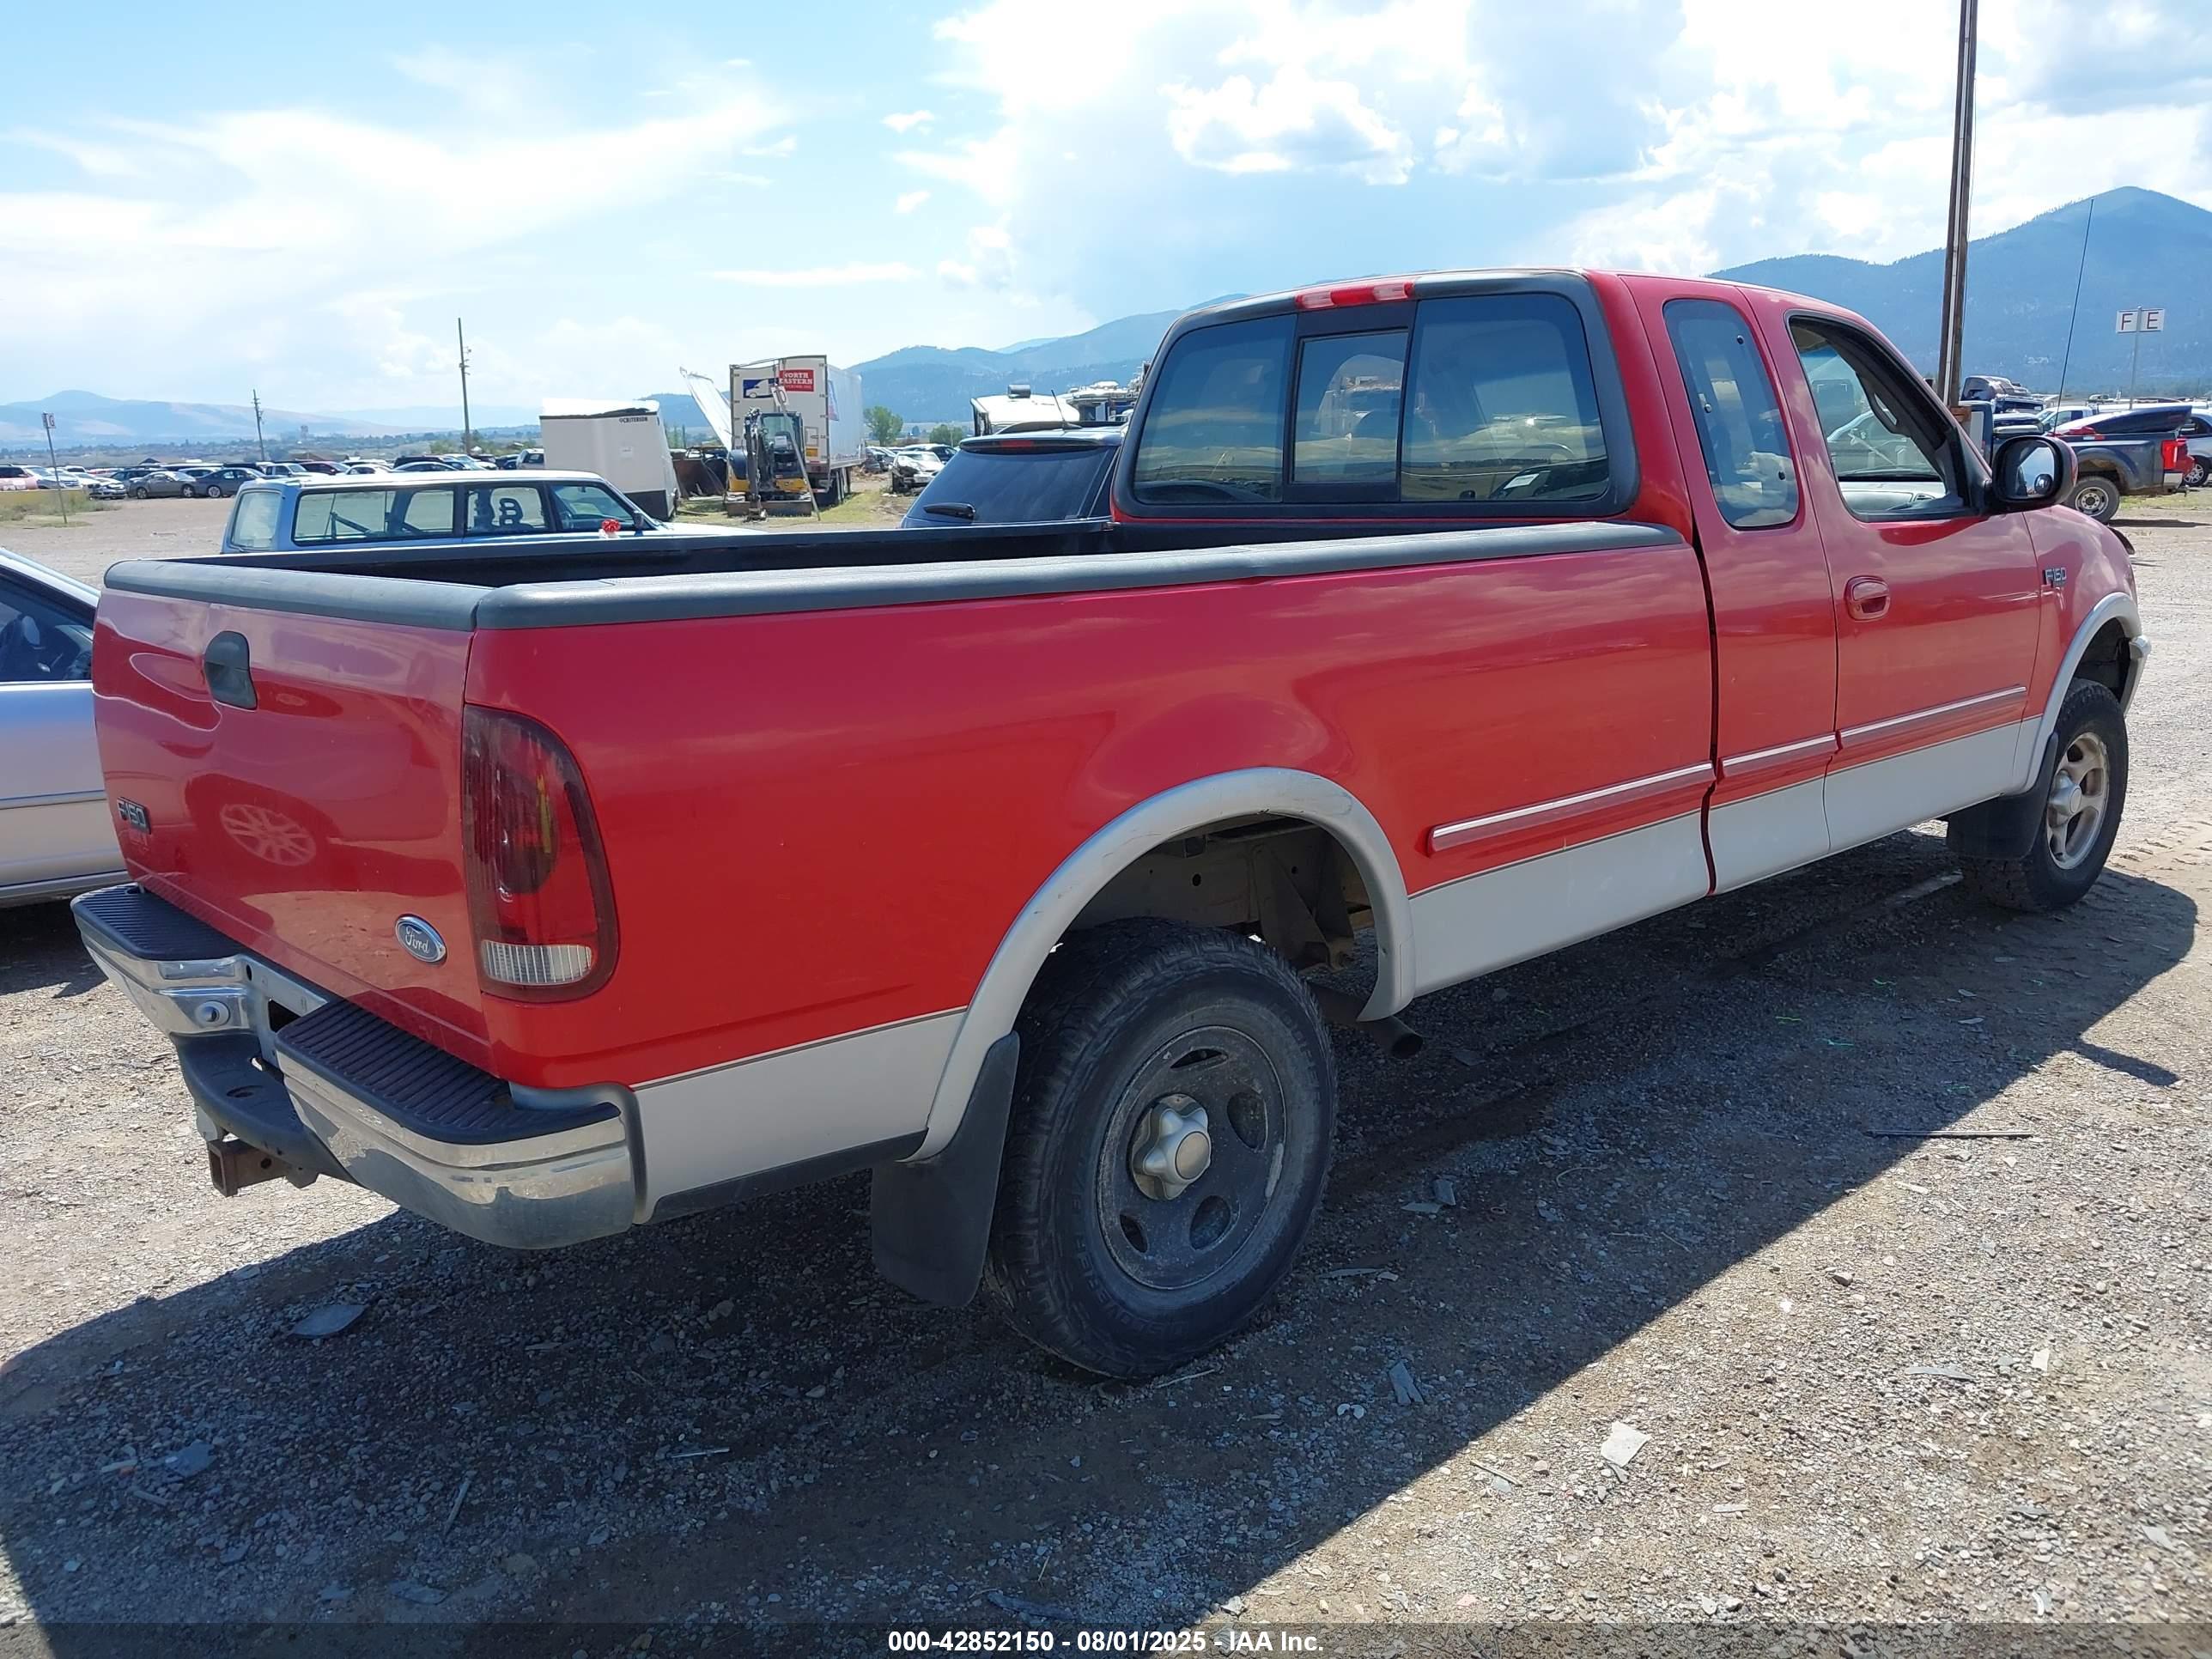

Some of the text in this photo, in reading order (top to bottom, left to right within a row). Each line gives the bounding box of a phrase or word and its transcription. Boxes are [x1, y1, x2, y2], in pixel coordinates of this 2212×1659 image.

[2121, 311, 2159, 331] F E
[405, 926, 430, 954] Ford
